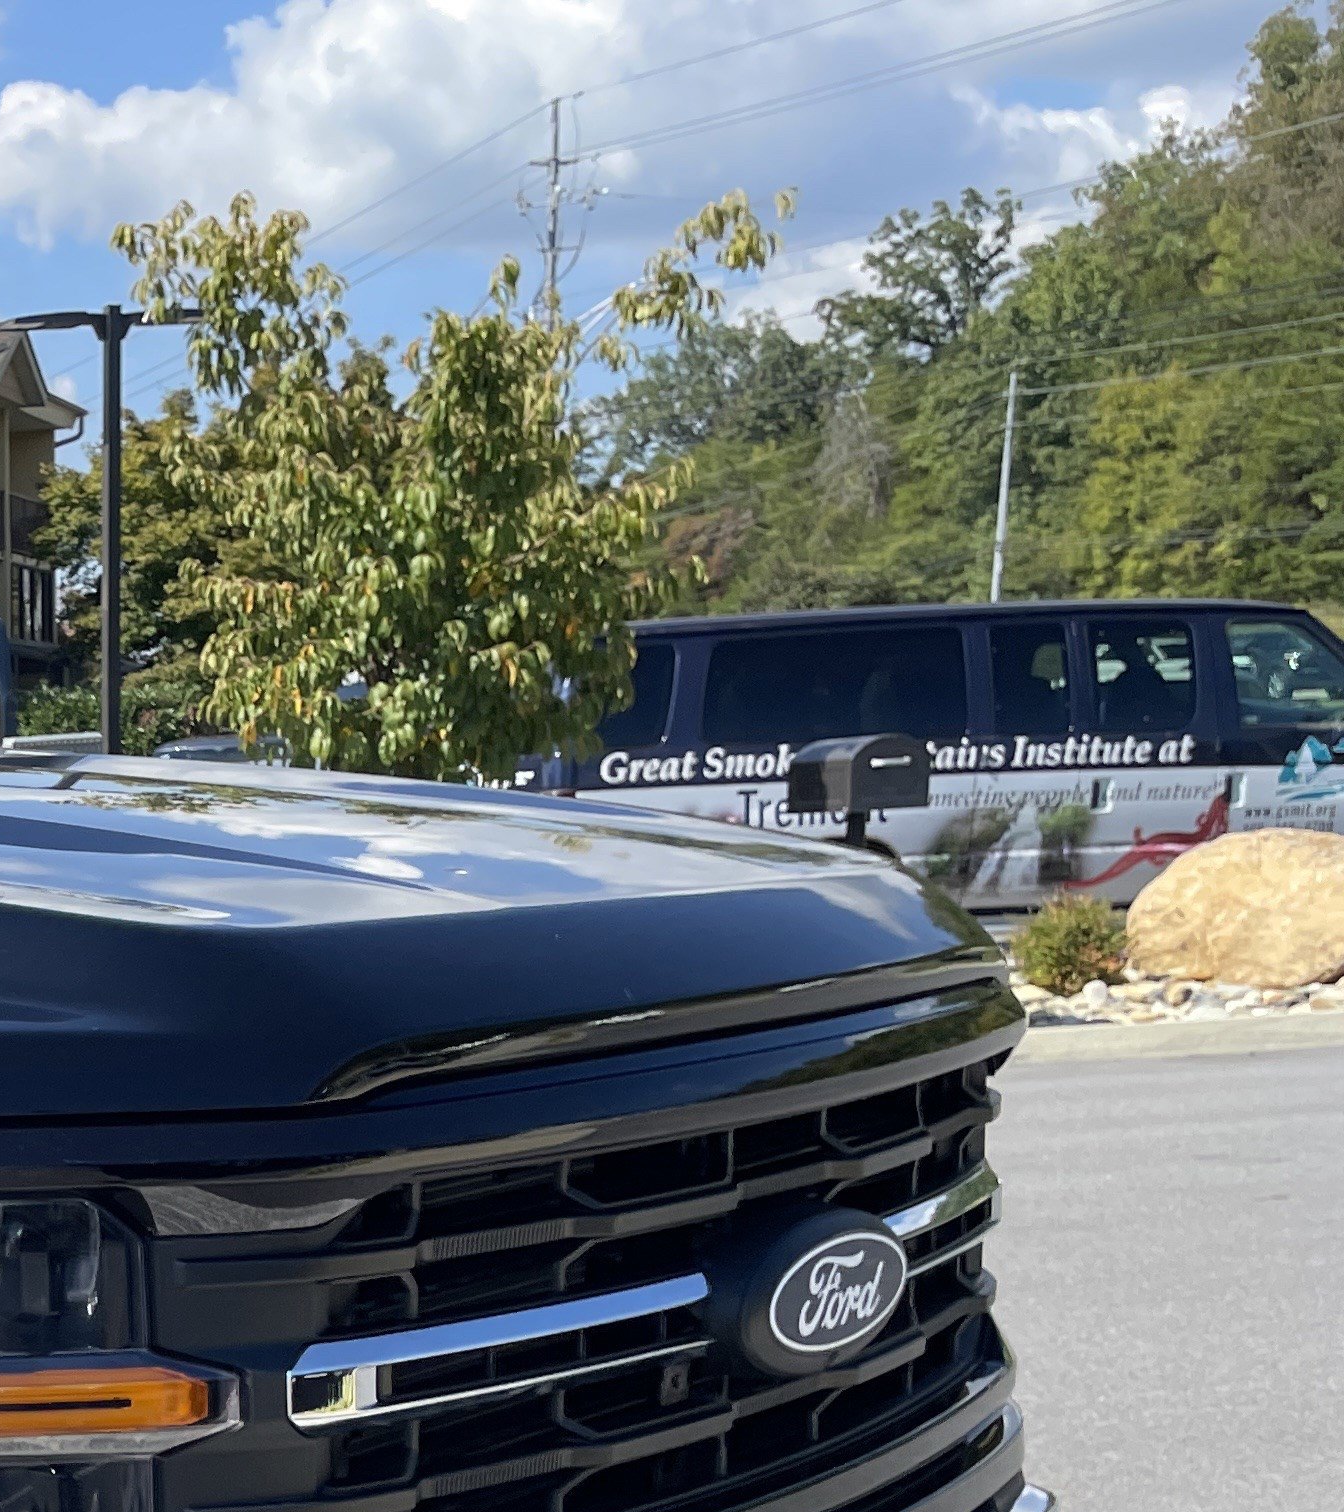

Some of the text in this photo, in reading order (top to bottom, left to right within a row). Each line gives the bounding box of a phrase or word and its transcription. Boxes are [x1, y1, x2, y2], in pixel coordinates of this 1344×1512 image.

[600, 751, 698, 784] Great
[702, 743, 797, 780] Smok
[1011, 733, 1152, 768] Institute
[1158, 733, 1195, 764] at
[798, 1250, 885, 1337] Ford
